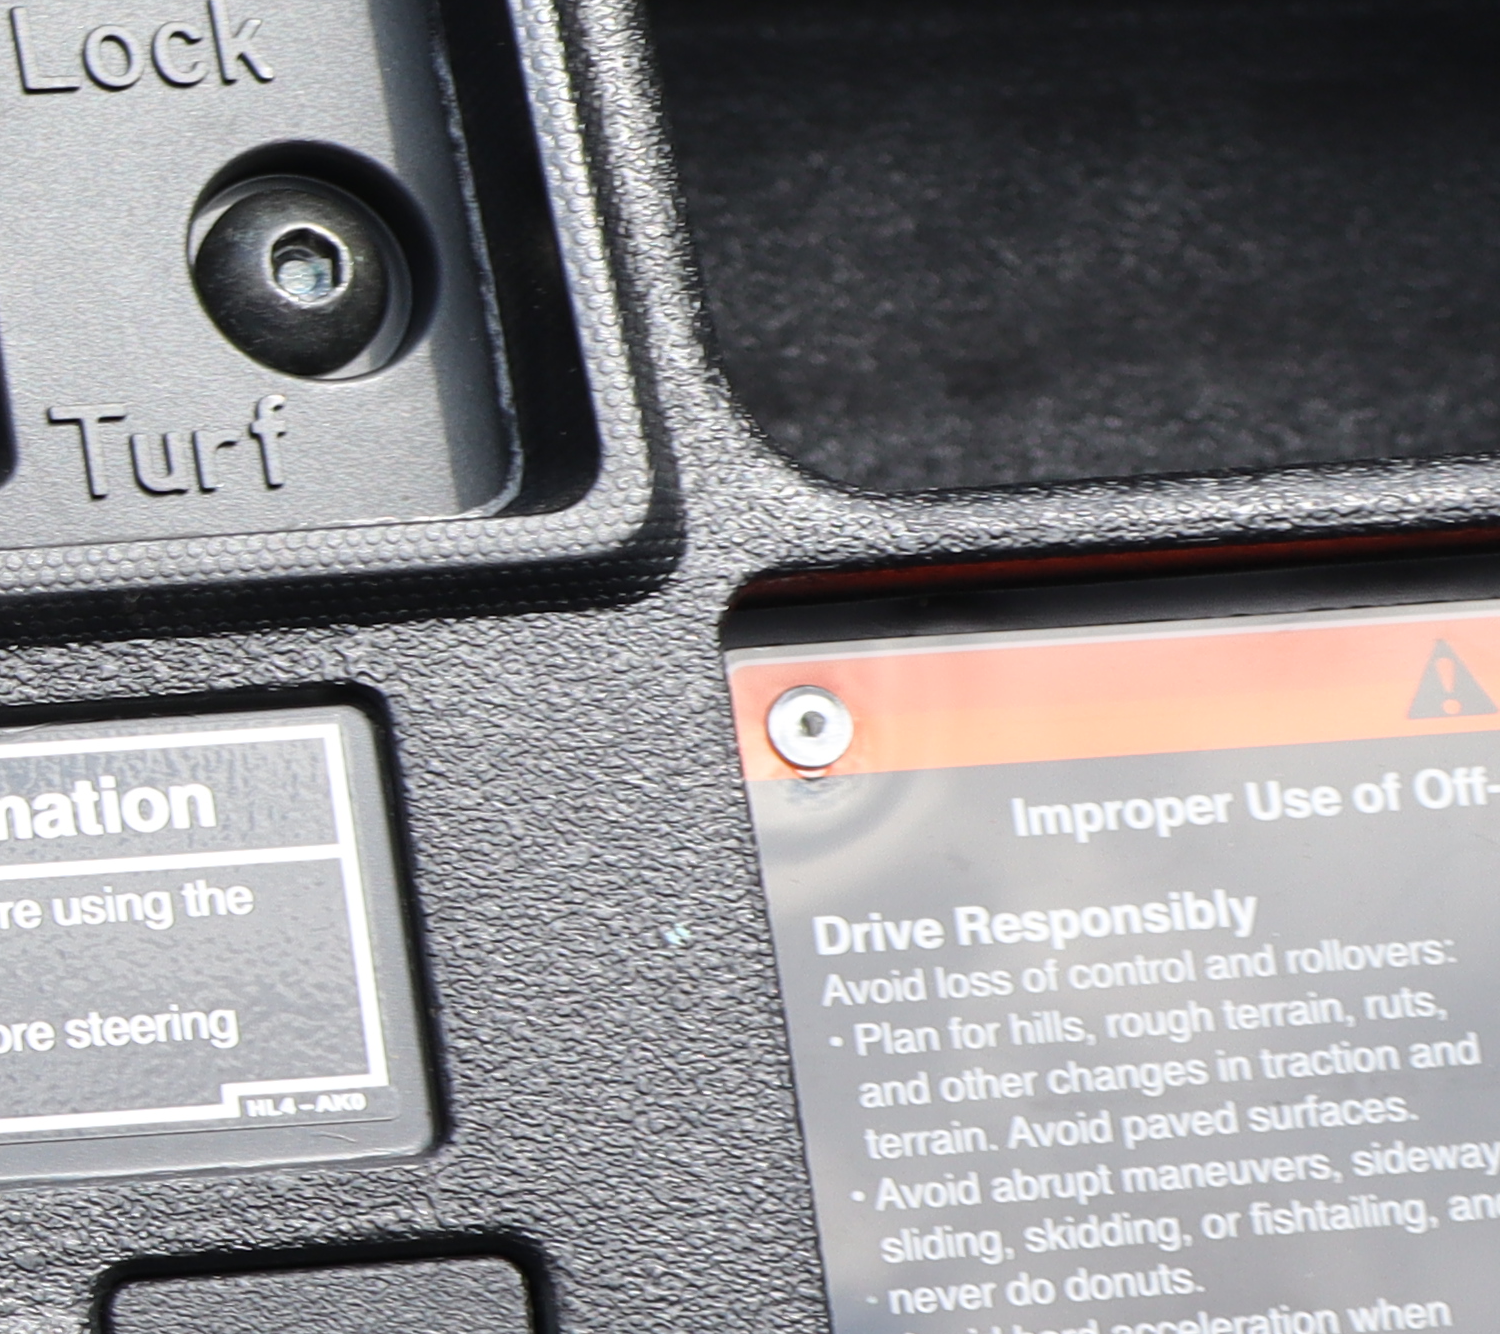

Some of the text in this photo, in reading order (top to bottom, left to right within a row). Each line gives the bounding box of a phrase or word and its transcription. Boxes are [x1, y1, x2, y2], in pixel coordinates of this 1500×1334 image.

[47, 394, 289, 499] Turf
[1013, 793, 1232, 843] Improper
[1246, 781, 1341, 820] Use
[1354, 773, 1400, 813] of
[53, 887, 172, 929] using
[182, 880, 252, 916] the
[814, 890, 1256, 955] Drive Responsibly
[823, 940, 1455, 1006] Avoid loss of control and rollovers:
[65, 1004, 238, 1048] steering
[855, 988, 1446, 1055] Plan for hills, rough terrain, ruts,
[861, 1033, 1481, 1107] and other changes in traction and
[865, 1095, 1418, 1159] terrain. Avoid paved surfaces.
[876, 1172, 980, 1210] Avoid
[992, 1165, 1113, 1204] abrupt
[1123, 1154, 1341, 1192] maneuvers,
[881, 1194, 1500, 1264] sliding, skidding, or fishtailing, an
[890, 1264, 1204, 1314] never do donuts.
[1347, 1298, 1451, 1332] when
